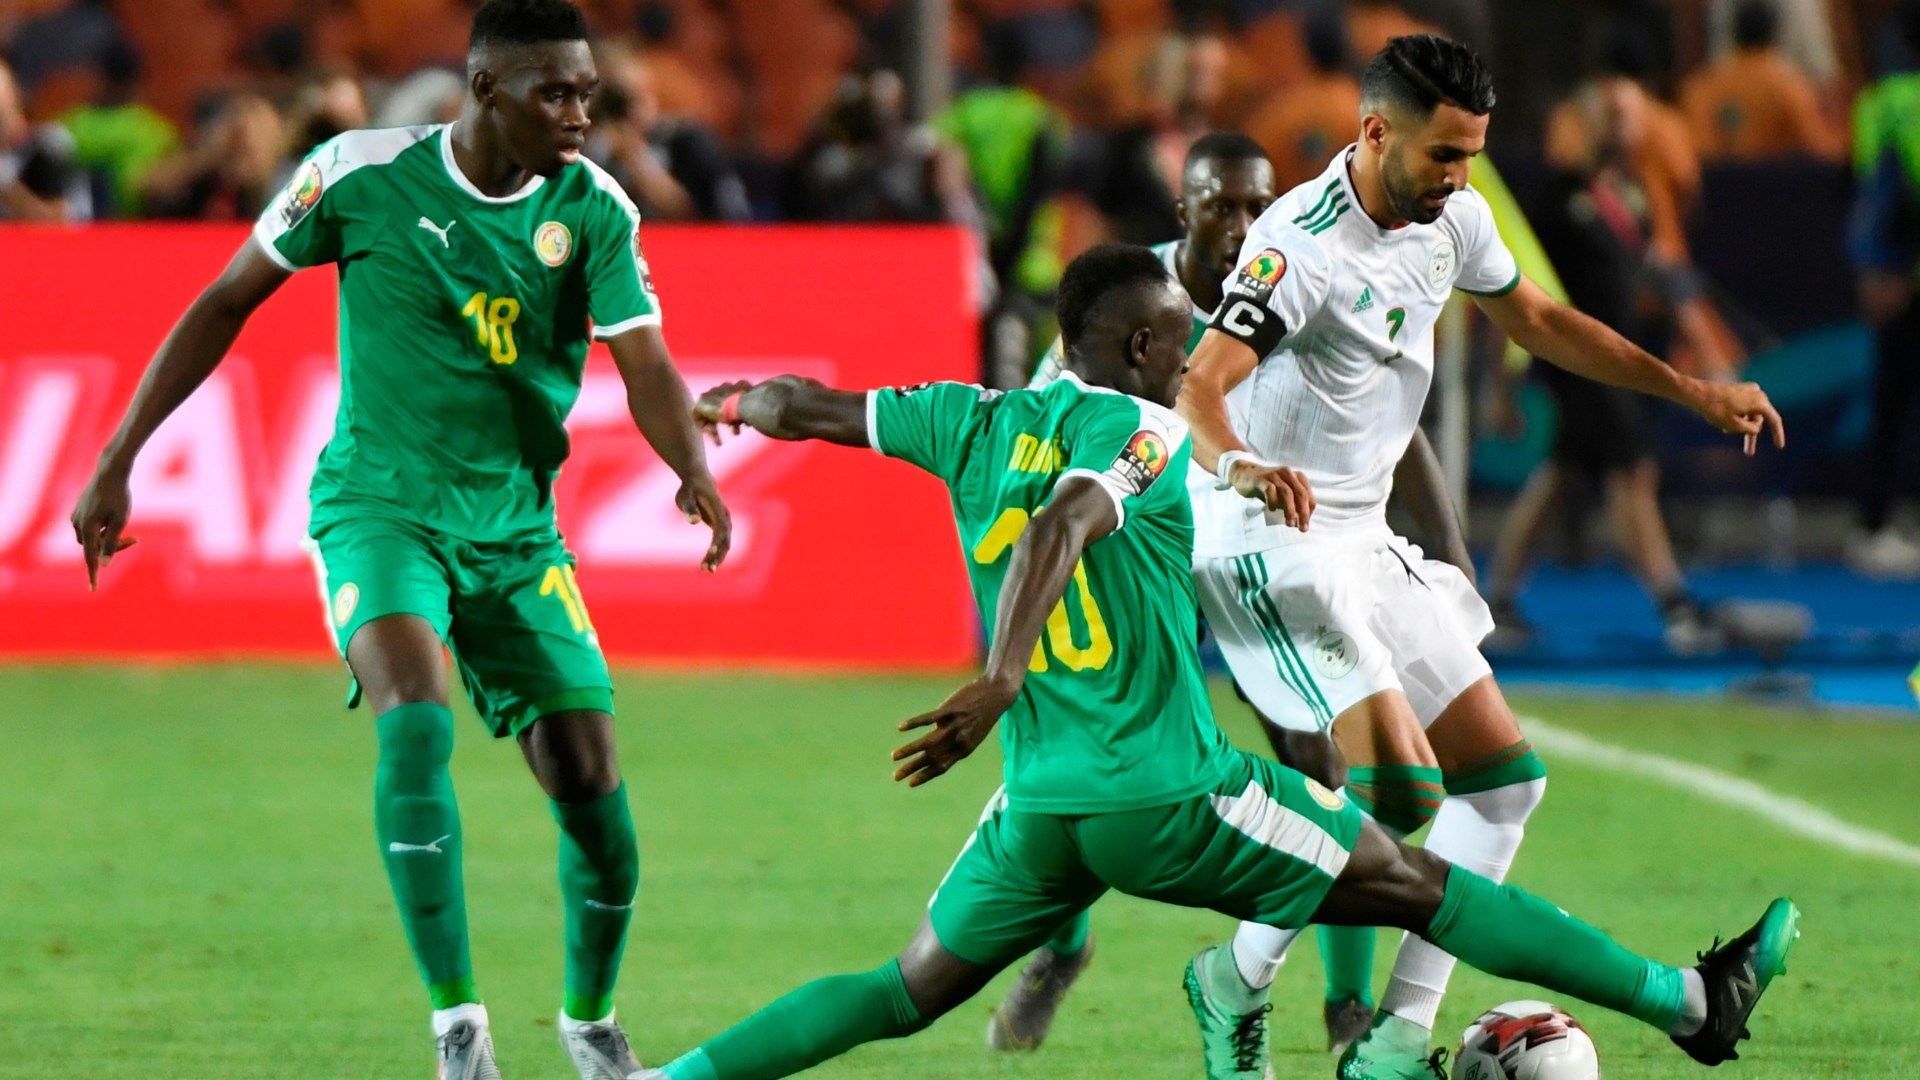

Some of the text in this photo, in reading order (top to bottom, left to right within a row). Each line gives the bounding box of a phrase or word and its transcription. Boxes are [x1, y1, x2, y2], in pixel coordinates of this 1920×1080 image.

[462, 291, 520, 364] 18
[1222, 300, 1265, 336] C
[973, 505, 1114, 673] 10
